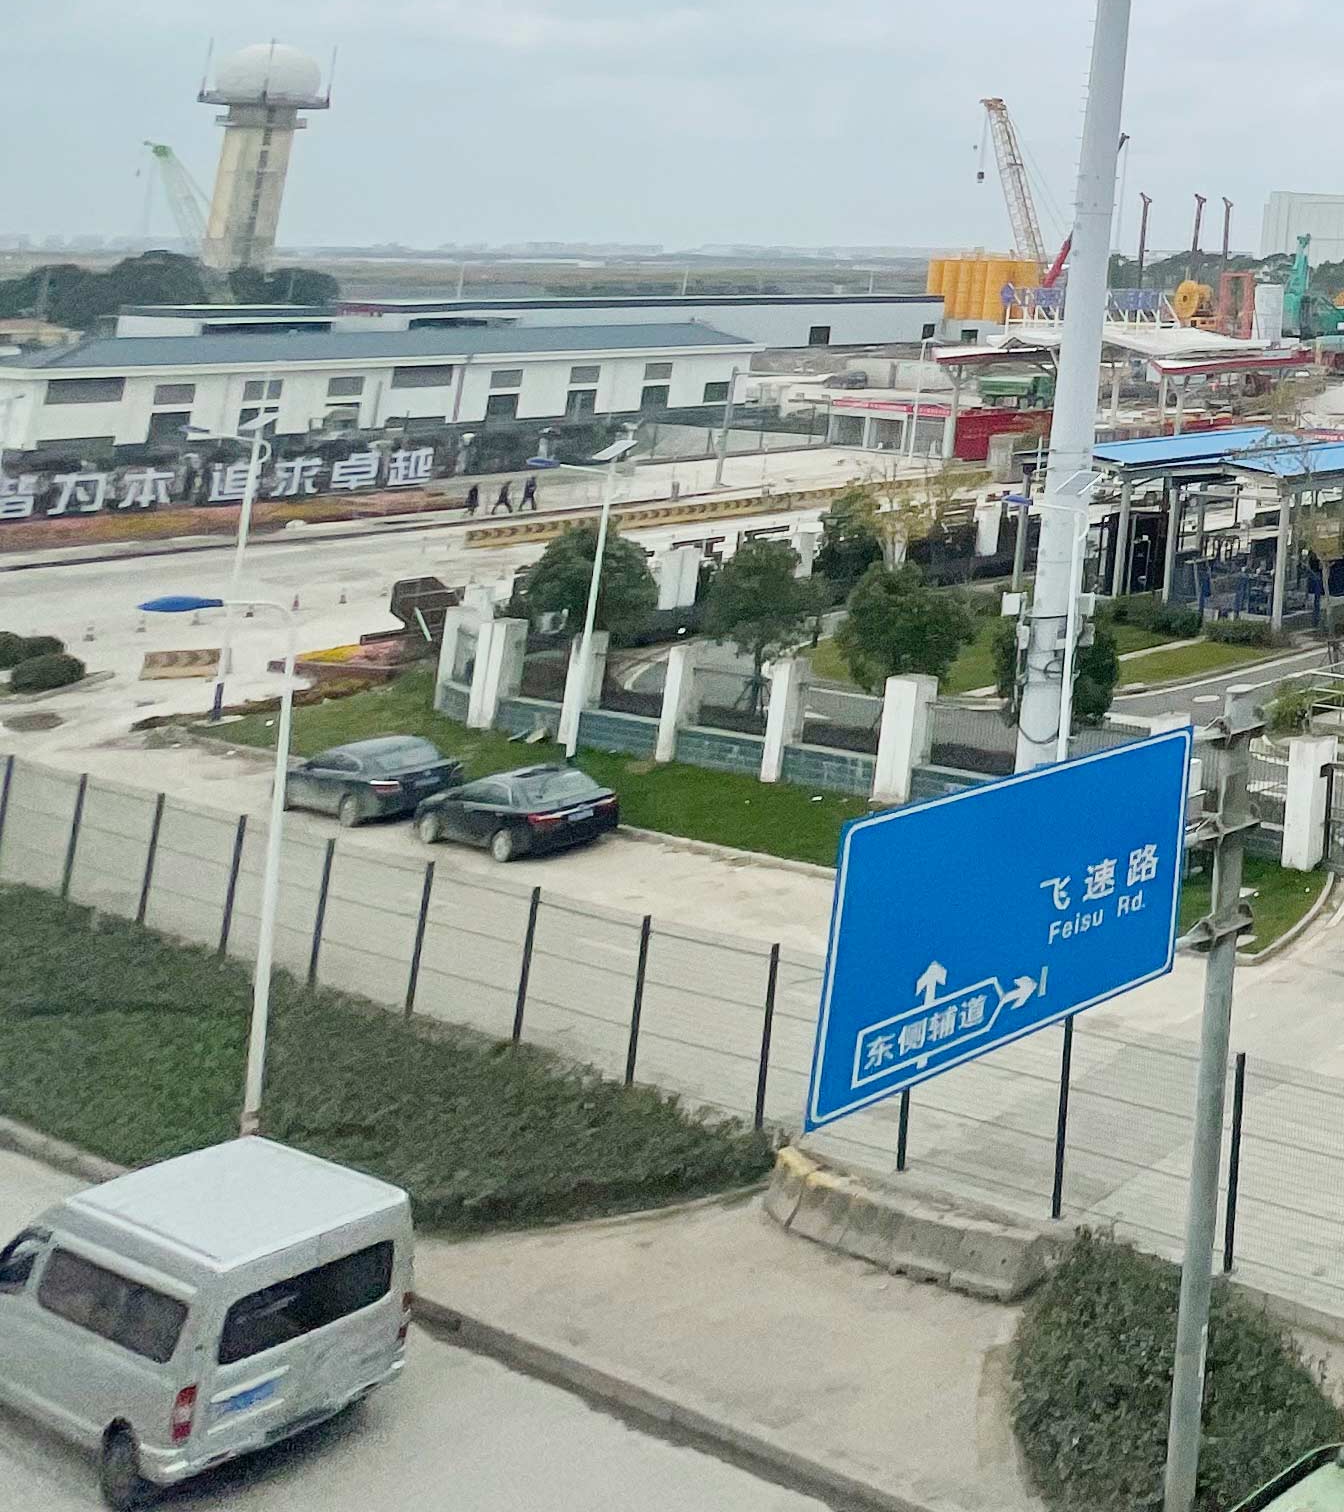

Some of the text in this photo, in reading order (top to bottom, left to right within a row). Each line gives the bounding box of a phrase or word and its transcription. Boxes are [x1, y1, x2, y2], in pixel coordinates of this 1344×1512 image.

[207, 447, 434, 502] 追求卓越
[1040, 843, 1160, 911] 飞速路
[1047, 908, 1104, 945] Feisu
[863, 994, 988, 1071] 东侧辅道
